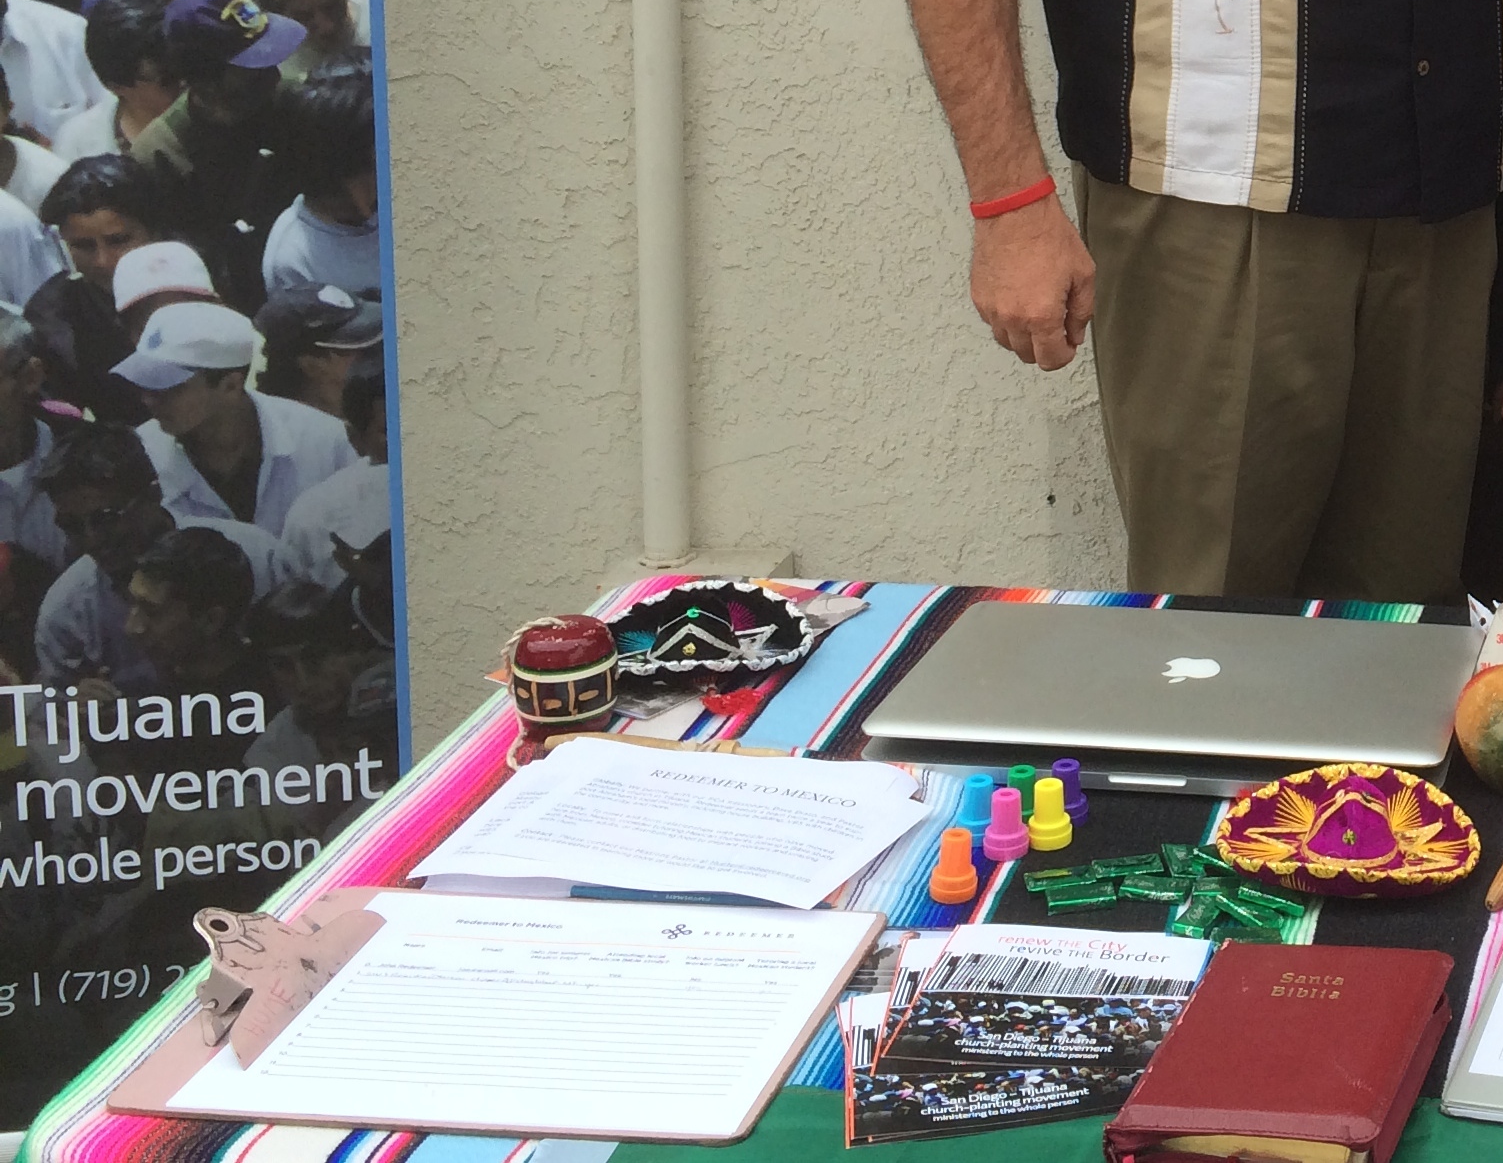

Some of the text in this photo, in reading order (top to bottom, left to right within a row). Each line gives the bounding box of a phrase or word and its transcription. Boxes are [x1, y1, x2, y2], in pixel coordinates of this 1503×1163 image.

[0, 685, 265, 763] Tijuana
[16, 747, 384, 821] movement
[650, 769, 857, 808] REDEEMER TO MEXICO
[0, 837, 321, 891] whole person
[455, 919, 510, 927] Redeemer
[525, 922, 563, 930] Mexico
[998, 935, 1128, 953] renew THE City
[1009, 945, 1170, 963] revive THE Border
[58, 967, 150, 1004] (719)
[1280, 972, 1345, 986] Santa
[1271, 985, 1341, 1000] Biblia
[954, 1038, 1114, 1053] church-planting movement
[1003, 1033, 1040, 1044] Diego
[1052, 1035, 1097, 1045] Tijuana
[961, 1047, 1013, 1057] ministering
[1013, 1049, 1023, 1057] to
[1040, 1051, 1068, 1059] whole
[920, 1088, 1090, 1116] church-planting movement
[941, 1096, 967, 1106] San
[969, 1091, 1008, 1104] Diego
[1019, 1083, 1068, 1097] Tijuana
[932, 1109, 988, 1122] ministering
[1017, 1102, 1046, 1112] whole
[1047, 1097, 1080, 1109] person
